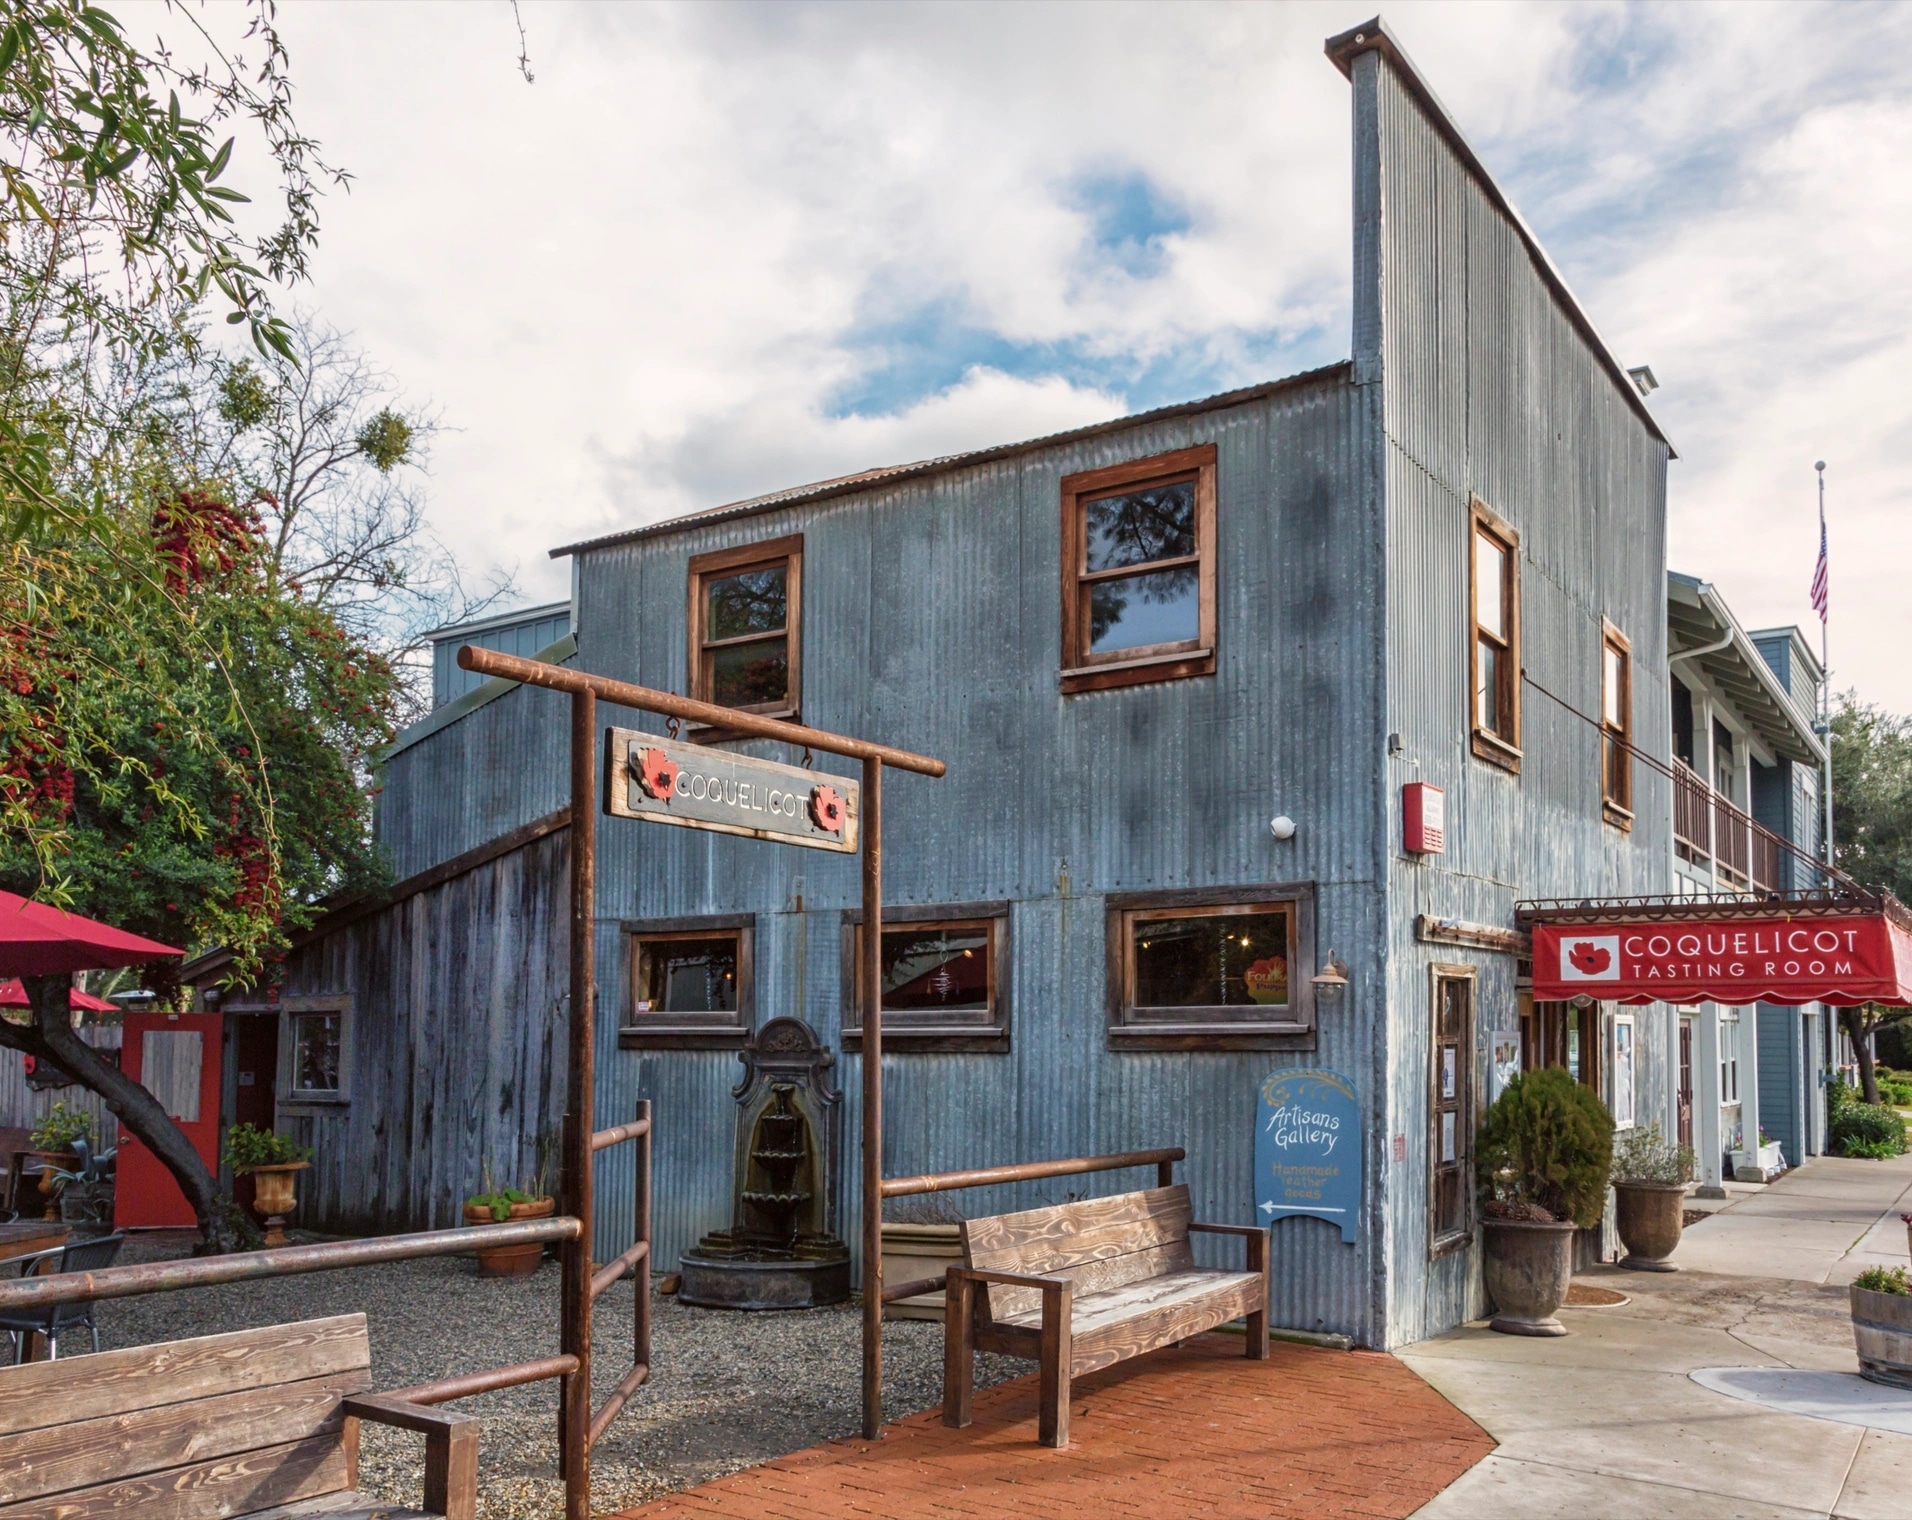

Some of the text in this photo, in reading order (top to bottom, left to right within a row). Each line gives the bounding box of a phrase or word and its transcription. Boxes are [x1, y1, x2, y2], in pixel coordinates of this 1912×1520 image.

[675, 770, 809, 820] COQUELICOT
[1625, 929, 1858, 957] COQUELICOT
[1633, 961, 1852, 978] TASTING ROOM
[1265, 1104, 1340, 1132] Artisans
[1275, 1126, 1339, 1156] Gallery
[1272, 1160, 1339, 1177] Handmade
